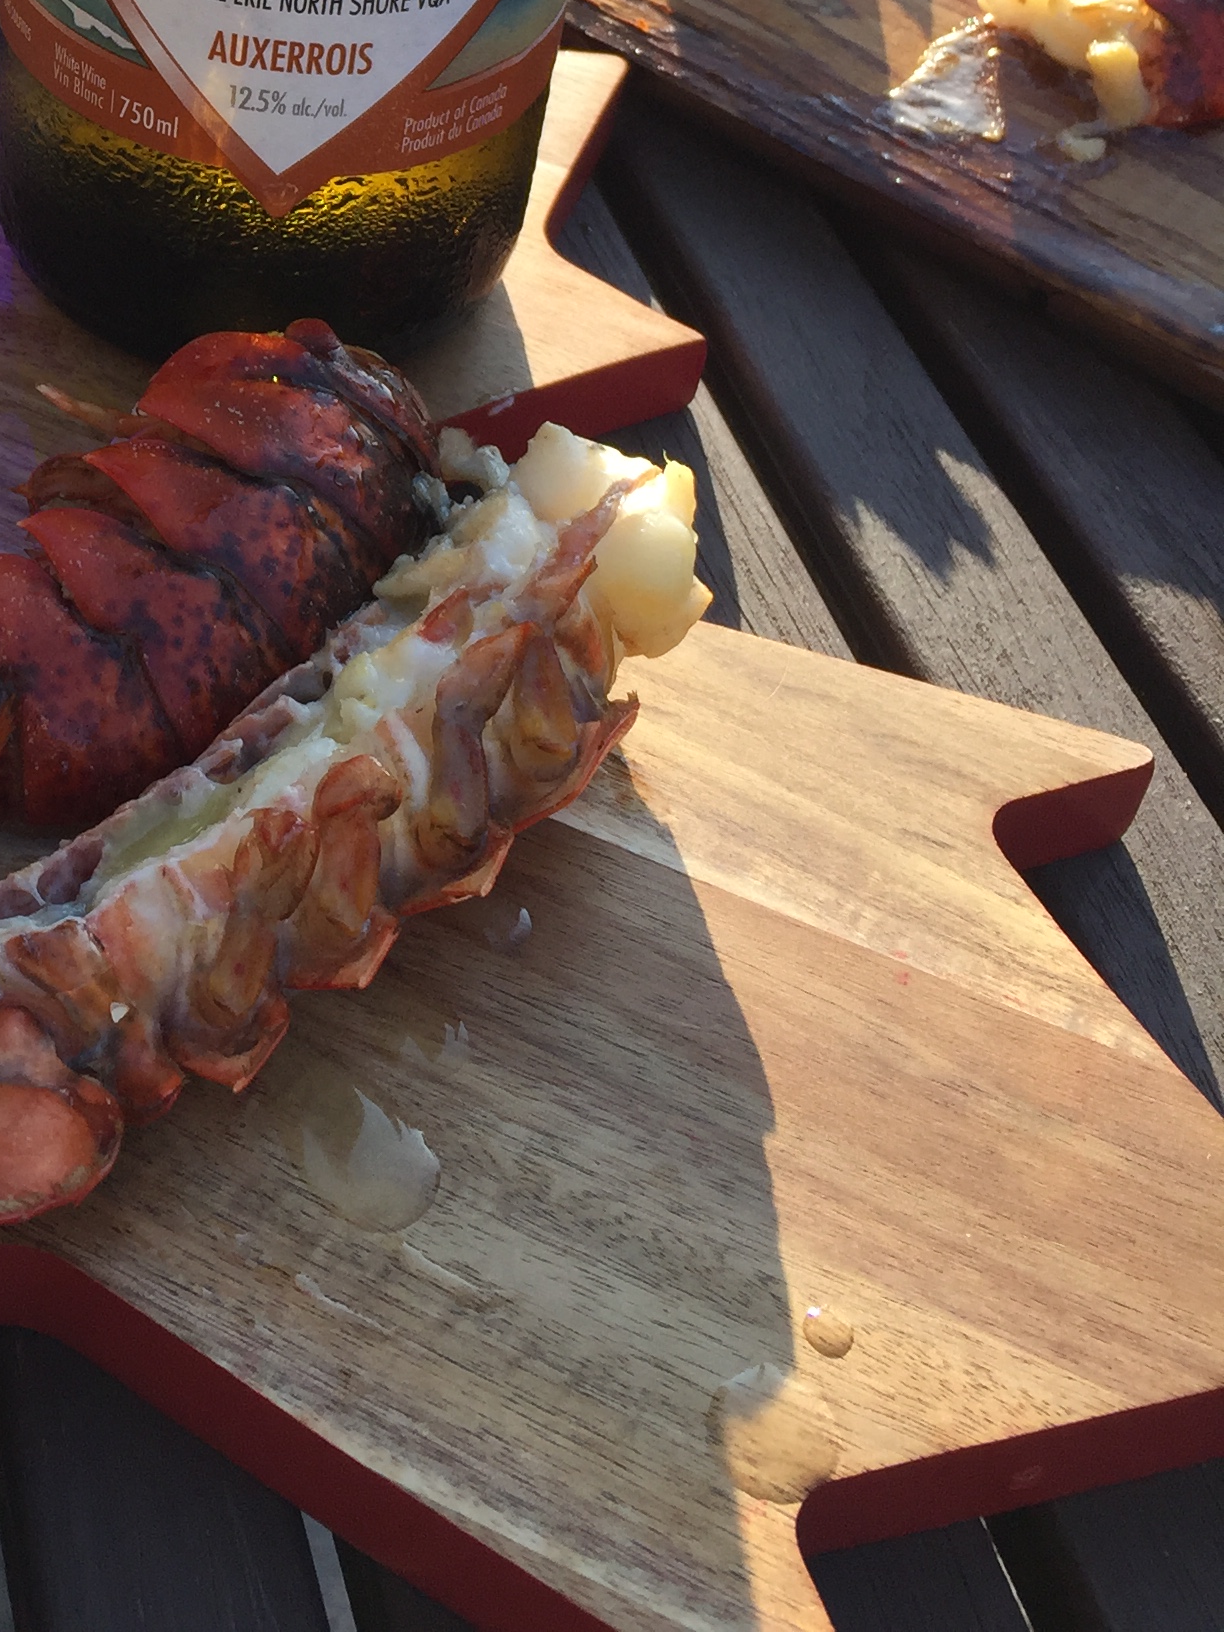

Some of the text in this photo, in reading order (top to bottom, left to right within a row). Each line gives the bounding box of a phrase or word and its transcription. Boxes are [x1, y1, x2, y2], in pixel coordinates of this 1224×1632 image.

[54, 41, 107, 91] White Wine
[207, 29, 374, 76] AUXERROIS
[53, 62, 105, 110] Vin Blanc
[228, 84, 348, 119] 12.5% alc./vol.
[403, 82, 508, 136] Product of Canada
[401, 102, 504, 154] Produit du Canada
